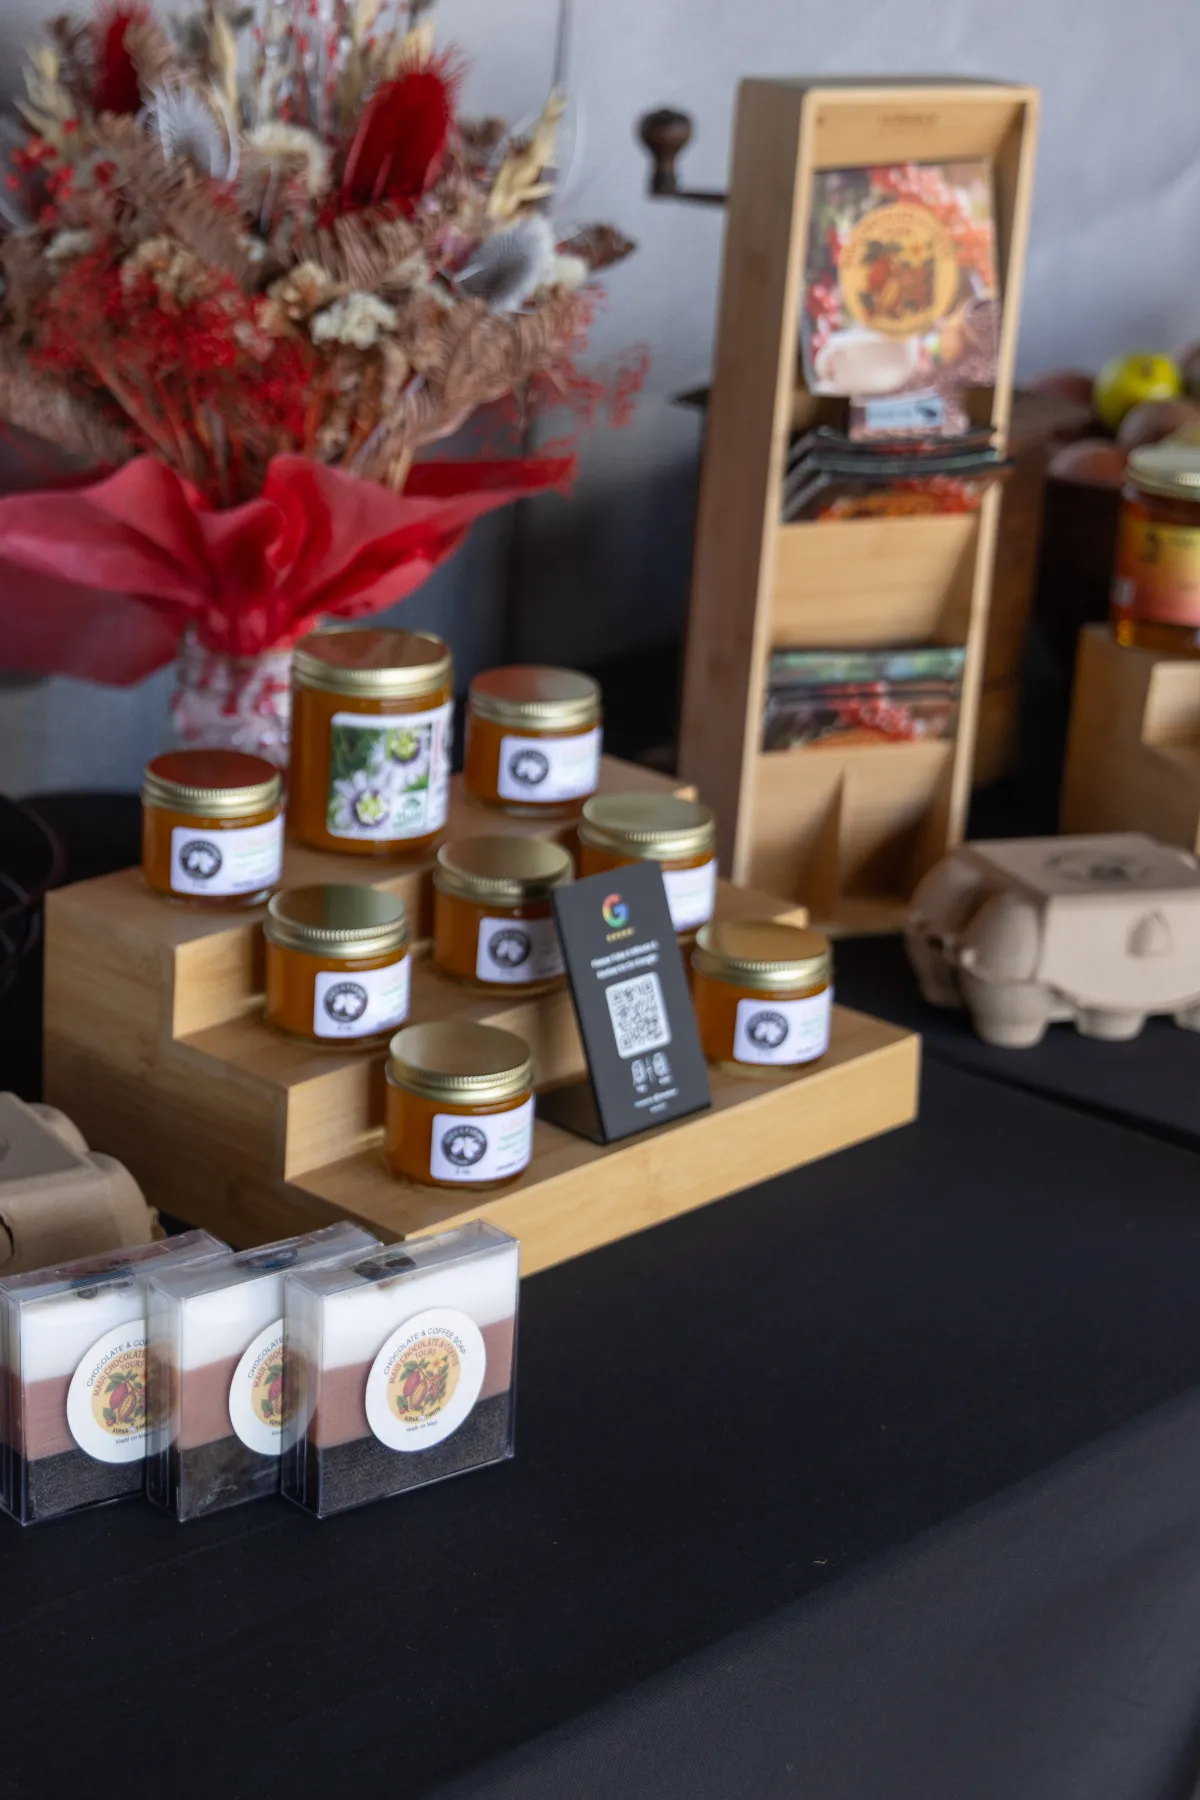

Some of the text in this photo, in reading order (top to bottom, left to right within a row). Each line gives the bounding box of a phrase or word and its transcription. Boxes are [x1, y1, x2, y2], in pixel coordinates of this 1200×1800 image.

[86, 1343, 125, 1387] CHOCOLATE
[383, 1327, 467, 1376] CHOCOLATE & COFFEE SOAP
[388, 1362, 402, 1384] MAUI
[400, 1337, 439, 1364] CHOCOLATE
[443, 1342, 460, 1368] COFFEE
[414, 1347, 437, 1361] TOURS
